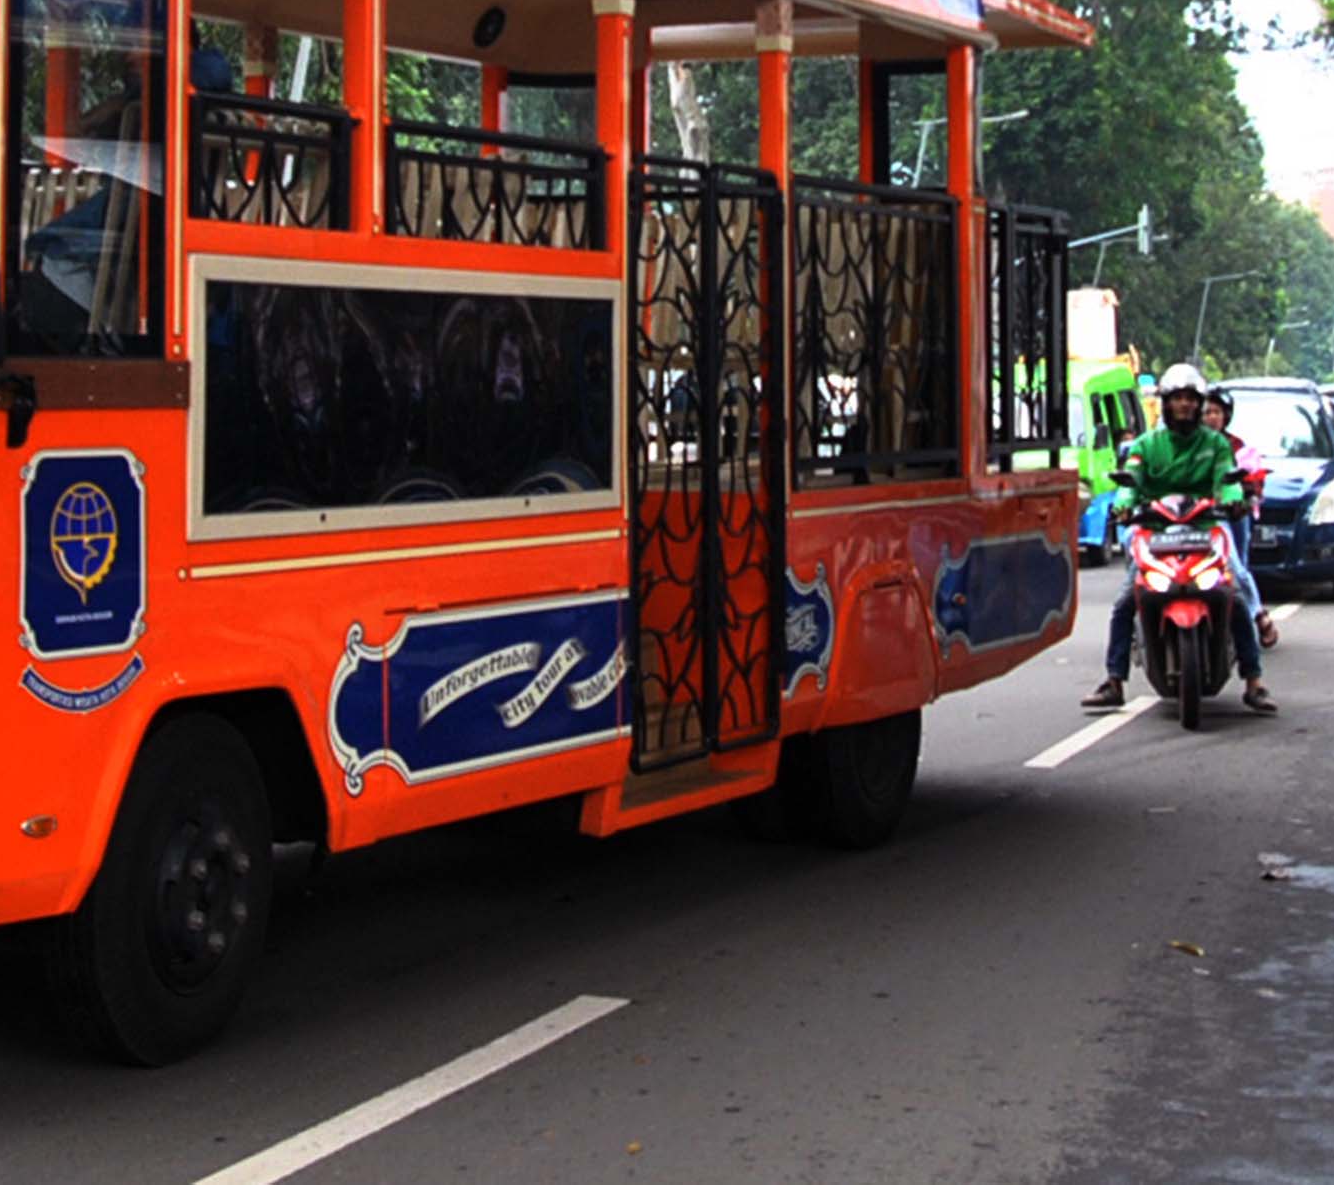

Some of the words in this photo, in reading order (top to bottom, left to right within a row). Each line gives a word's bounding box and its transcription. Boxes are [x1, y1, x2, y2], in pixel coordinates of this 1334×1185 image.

[423, 646, 539, 713] Unforgettable
[502, 692, 536, 722] city
[534, 659, 567, 695] tour
[565, 641, 582, 663] at
